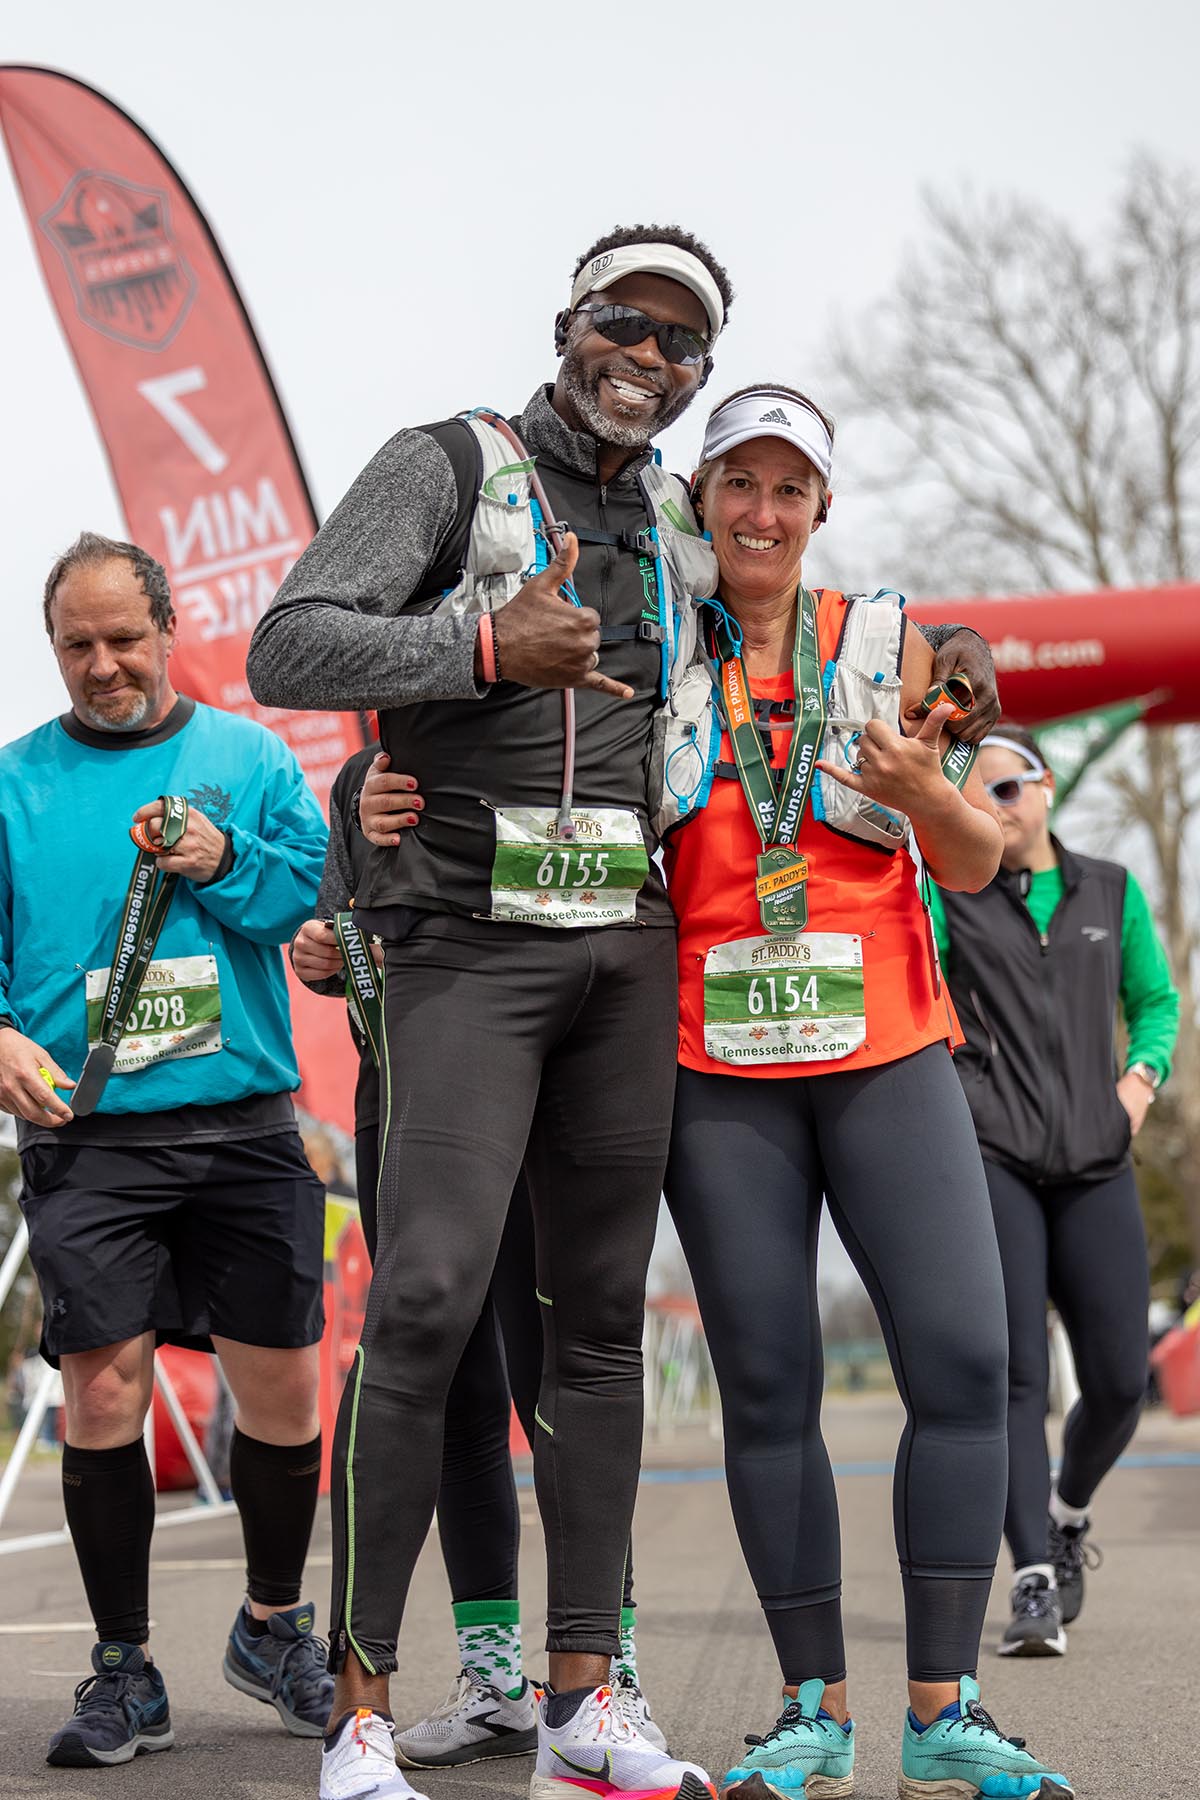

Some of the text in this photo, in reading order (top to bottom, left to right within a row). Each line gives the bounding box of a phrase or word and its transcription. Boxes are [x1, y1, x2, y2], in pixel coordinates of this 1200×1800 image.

[758, 415, 792, 428] adidas
[727, 661, 742, 705] PADDY'S
[575, 821, 603, 837] DDY'S
[536, 852, 610, 887] 6155
[758, 866, 807, 894] ST. PADDY'S
[508, 908, 624, 921] TennesseeRuns.com
[106, 863, 155, 1019] TennesseeRuns.com
[751, 945, 811, 964] ST. PADDY'S
[341, 920, 376, 1001] FINISHER
[144, 970, 176, 983] ADDY'S
[747, 975, 820, 1015] 6154
[113, 1040, 208, 1068] nnesseeRuns.com
[721, 1042, 849, 1058] TennesseeRuns.com
